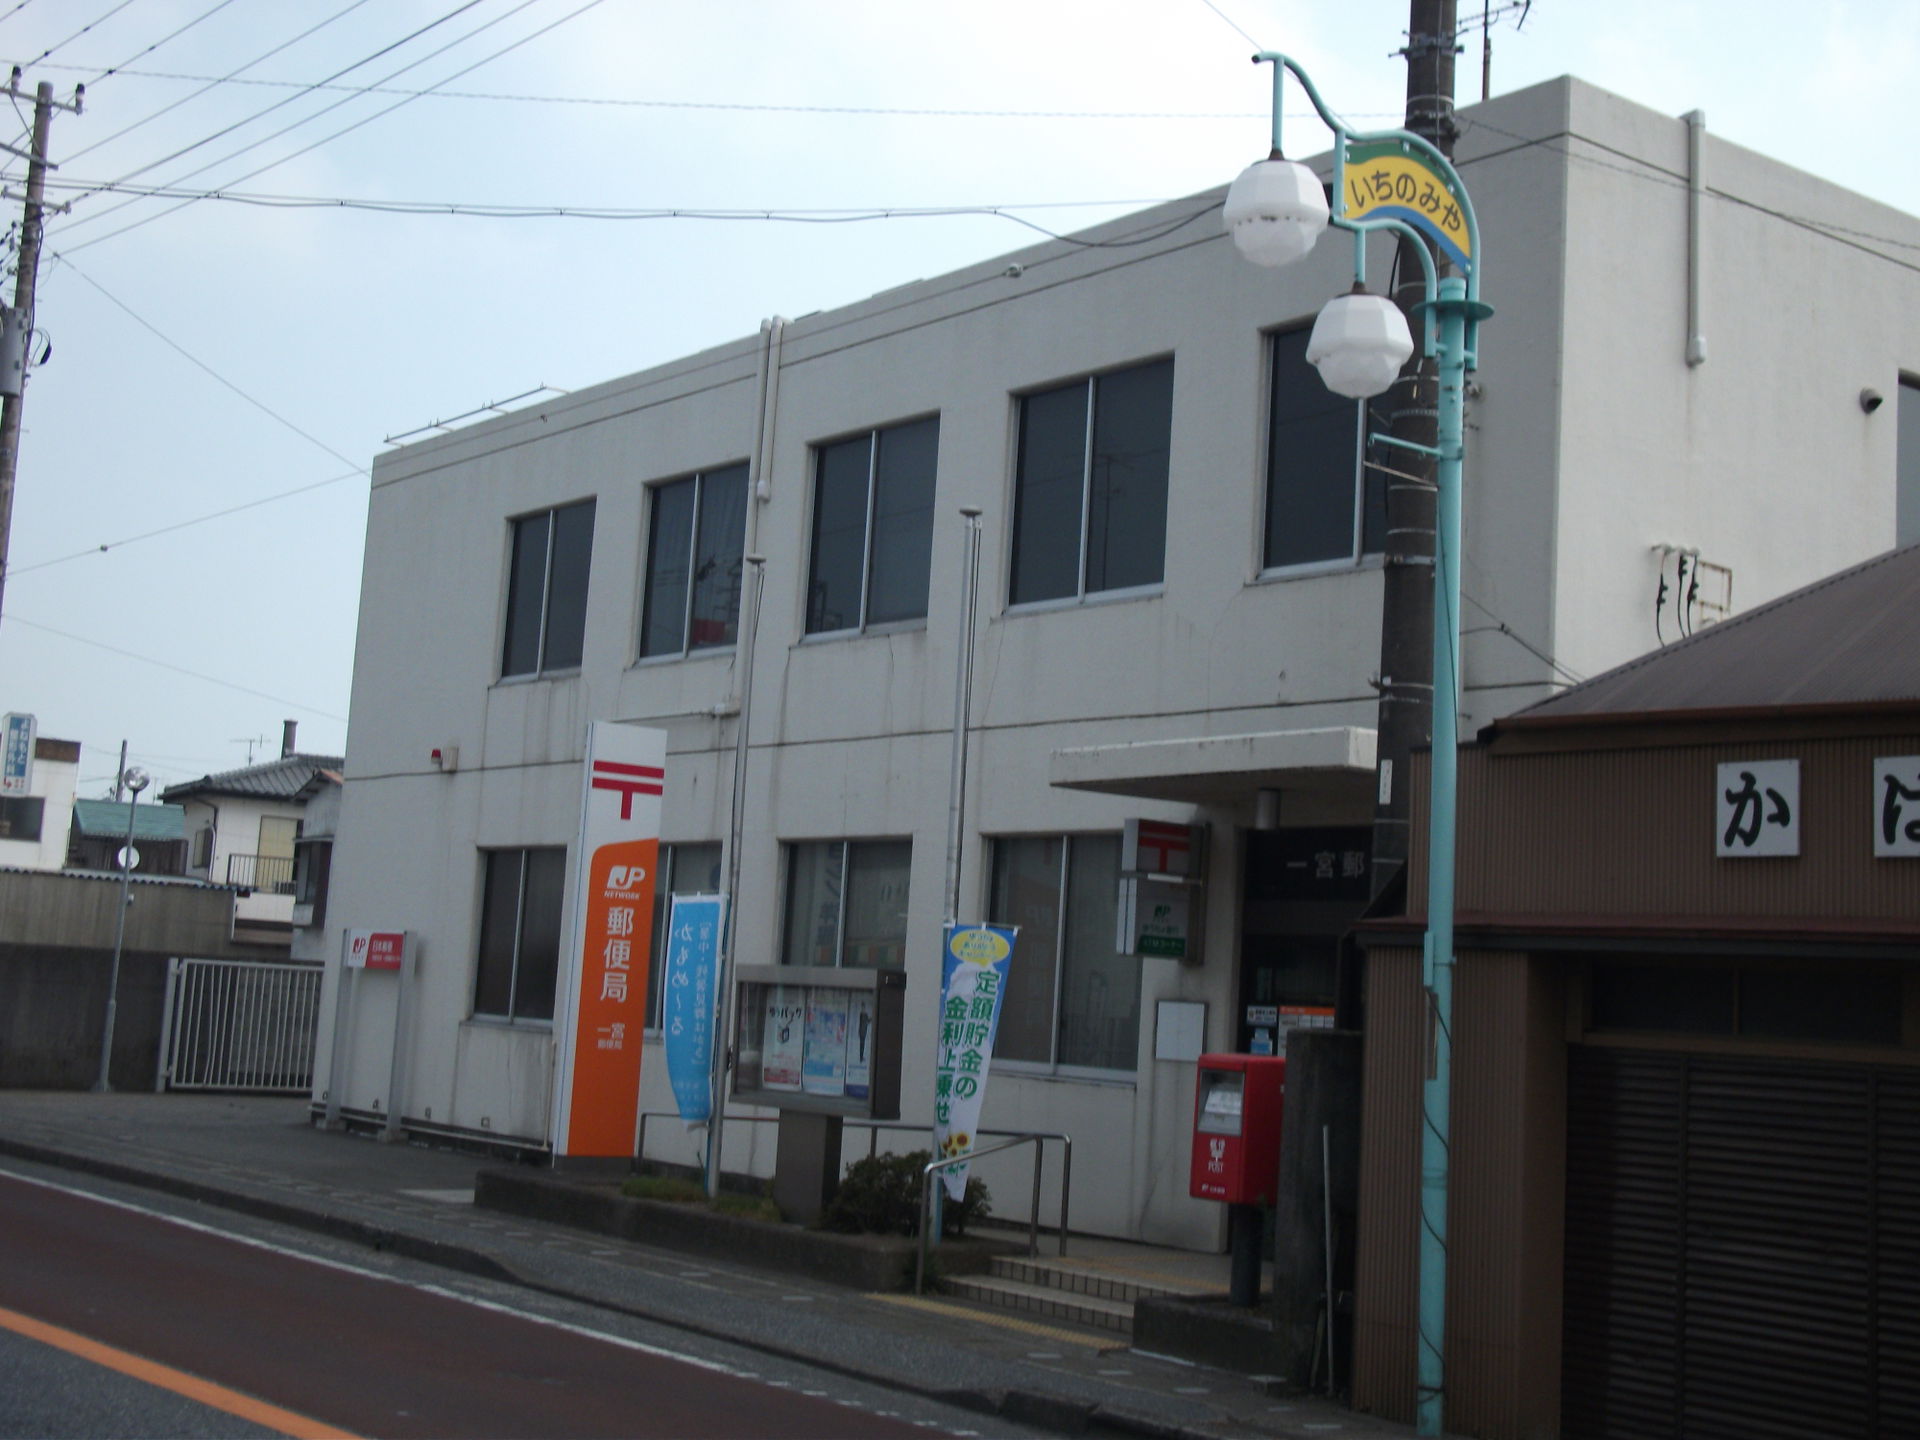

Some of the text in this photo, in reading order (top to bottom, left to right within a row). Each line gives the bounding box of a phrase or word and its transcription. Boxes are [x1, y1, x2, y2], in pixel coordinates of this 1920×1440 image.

[1351, 170, 1461, 231] いちのみや
[603, 890, 640, 900] NETWORK
[600, 906, 634, 1003] 郵便局
[597, 1023, 625, 1040] 一宮
[934, 997, 968, 1126] 金利上乗せ
[954, 971, 1000, 1099] 定額貯金の
[1207, 1160, 1224, 1173] POST
